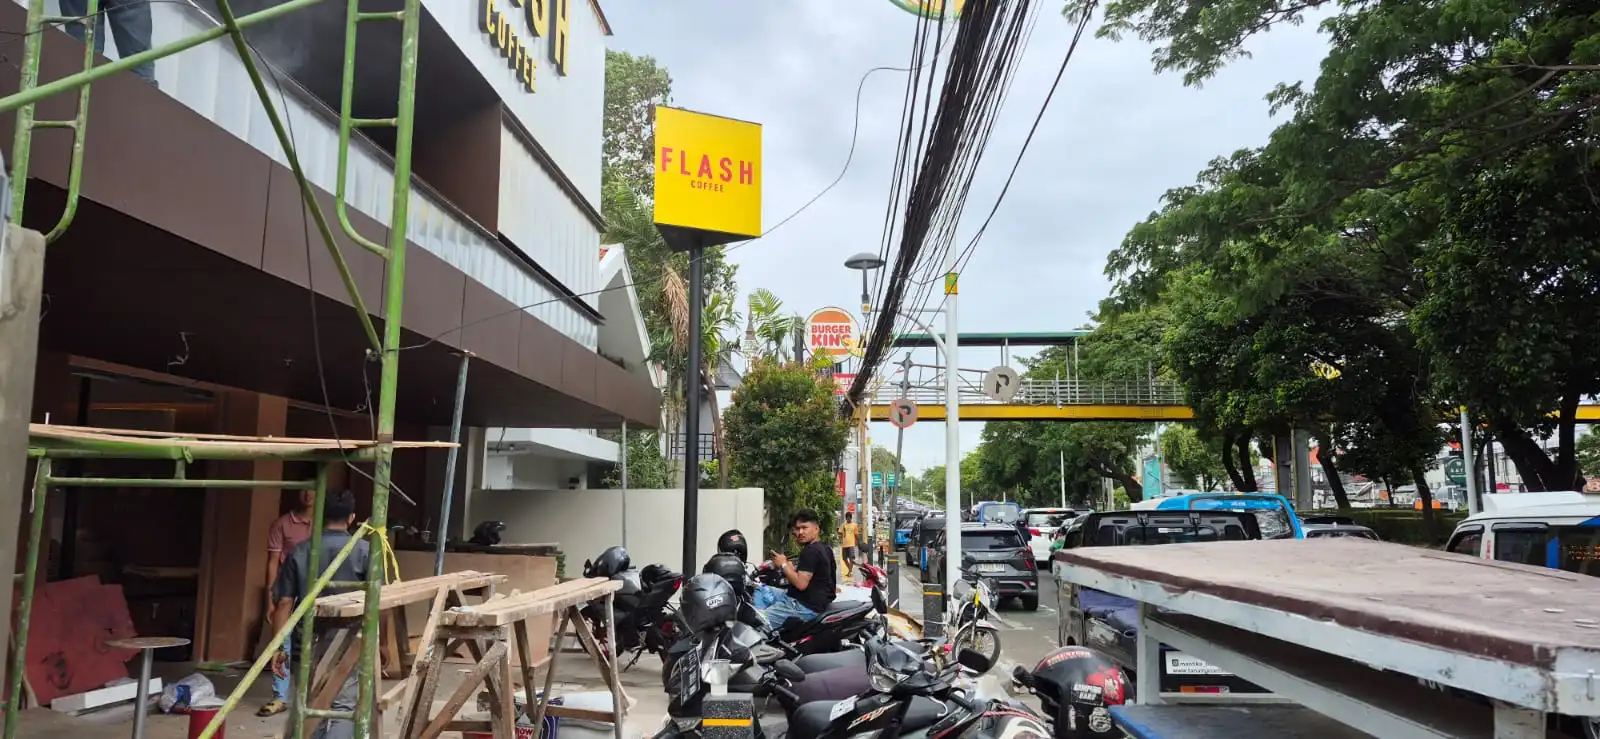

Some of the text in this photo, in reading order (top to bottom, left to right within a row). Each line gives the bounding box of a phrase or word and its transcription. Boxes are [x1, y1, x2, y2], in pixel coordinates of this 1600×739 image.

[661, 147, 753, 185] FLASH
[691, 180, 724, 193] COFFEE
[811, 325, 851, 334] BURGER
